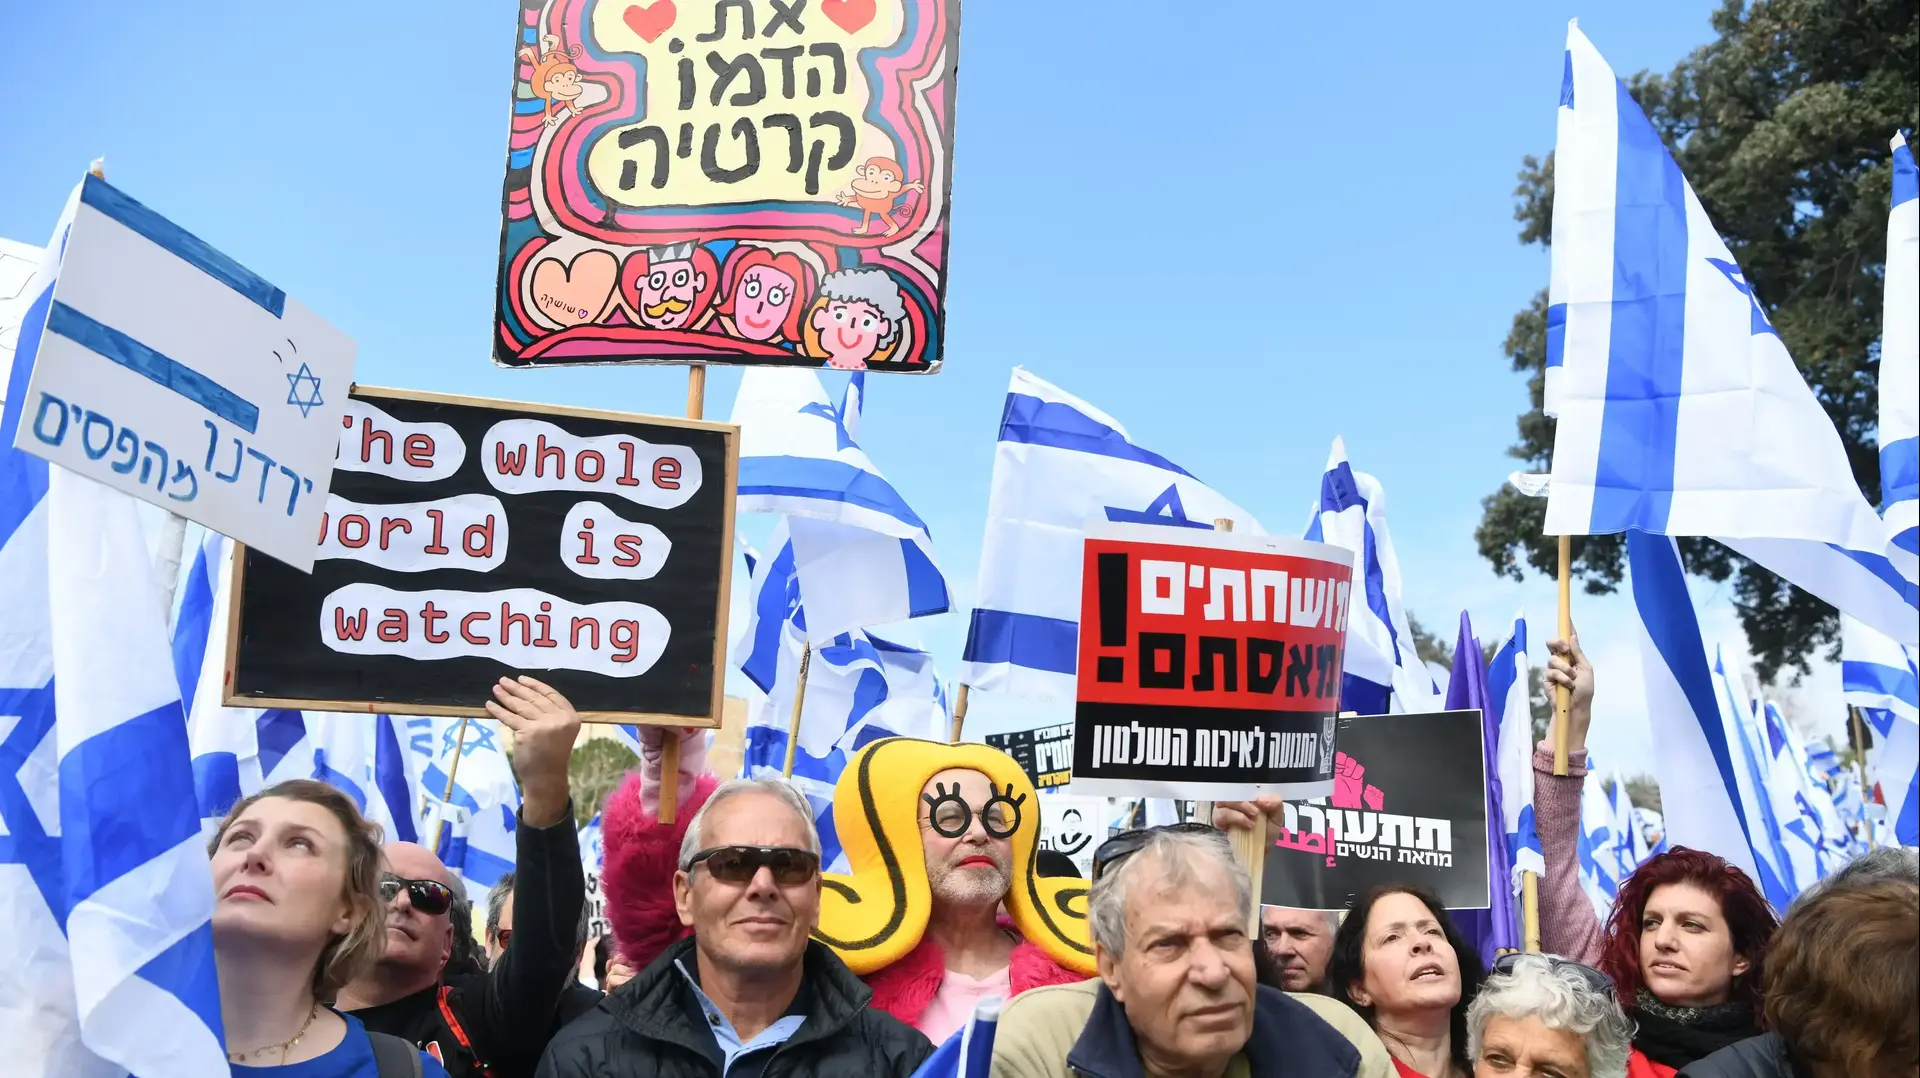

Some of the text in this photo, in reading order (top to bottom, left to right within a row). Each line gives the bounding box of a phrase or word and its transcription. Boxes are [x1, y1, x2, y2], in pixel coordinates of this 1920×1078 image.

[696, 0, 807, 42] את
[618, 110, 857, 196] קרטיה
[32, 391, 199, 502] מהפסים
[203, 419, 313, 517] ירדנו
[495, 433, 683, 490] whole
[575, 518, 643, 567] is
[1140, 559, 1349, 633] מושחתים
[334, 600, 640, 664] watching
[1091, 720, 1318, 769] התנועה לאיכות השלטון
[1281, 801, 1452, 852] תתעורר
[1335, 842, 1453, 868] מחאת הנשים
